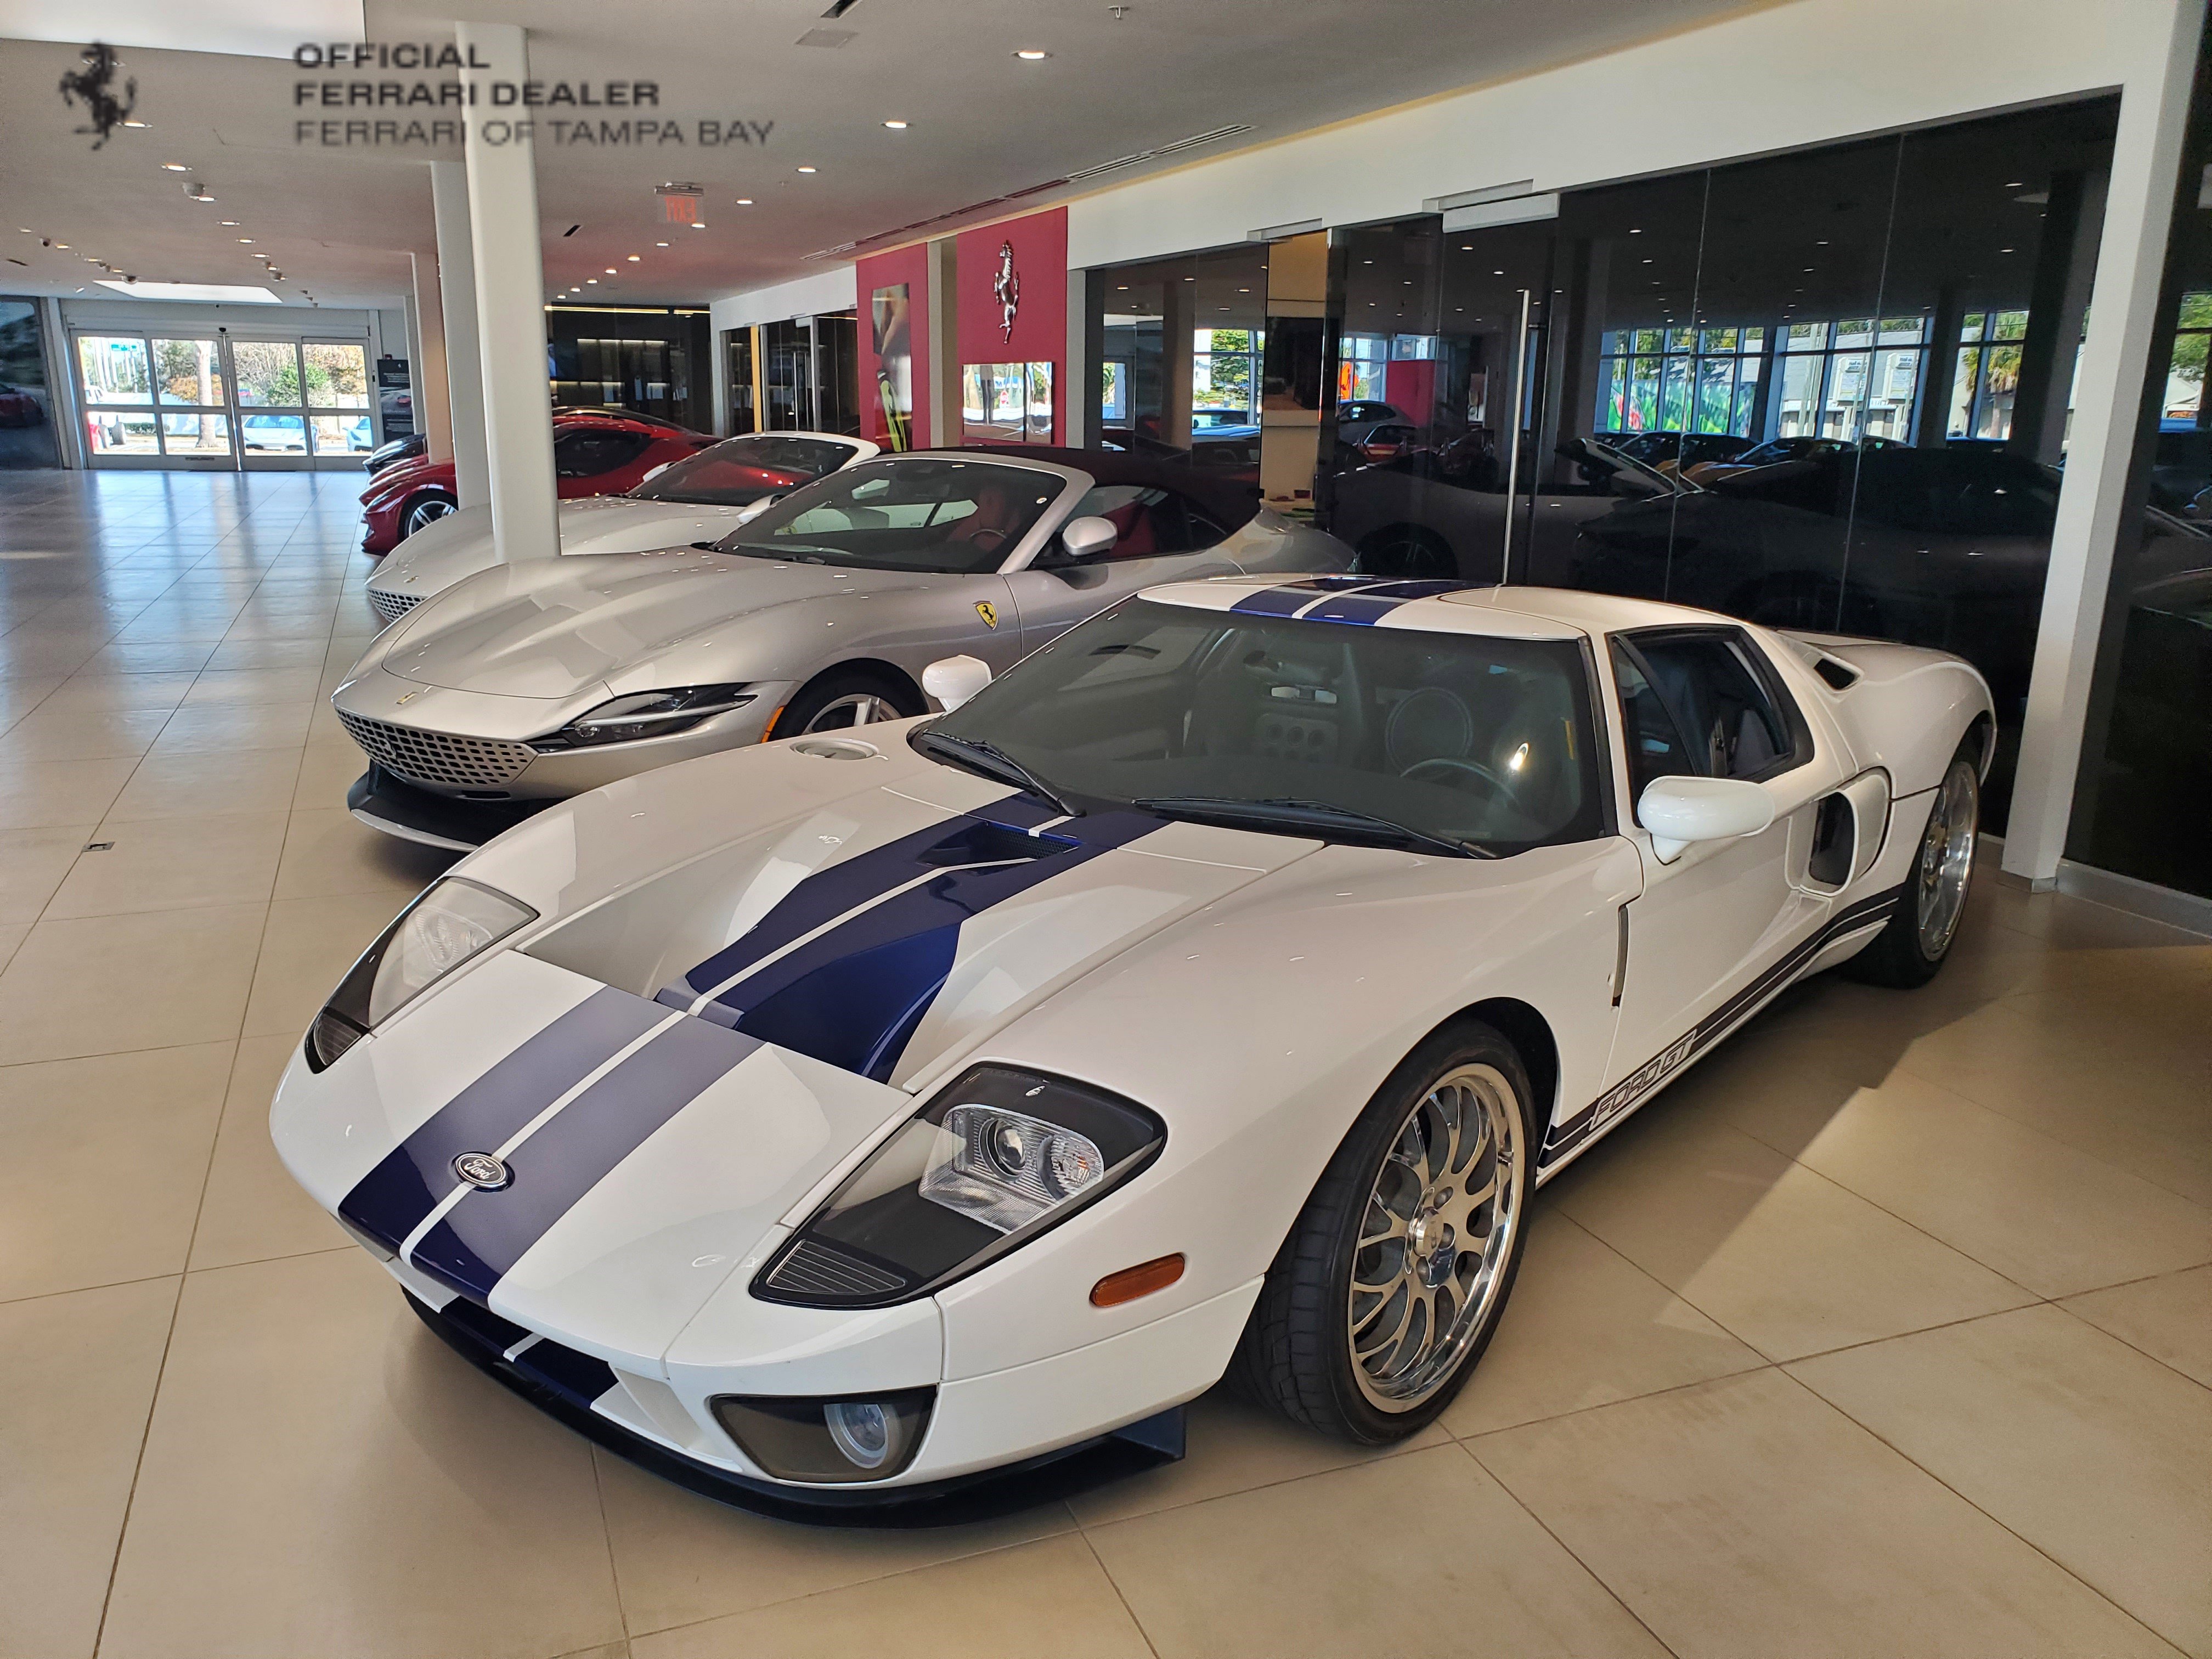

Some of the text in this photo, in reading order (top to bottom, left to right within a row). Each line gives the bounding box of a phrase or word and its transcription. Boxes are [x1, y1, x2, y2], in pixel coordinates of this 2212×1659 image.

[1593, 1033, 1695, 1126] FORD GT
[464, 1159, 496, 1180] Ford
